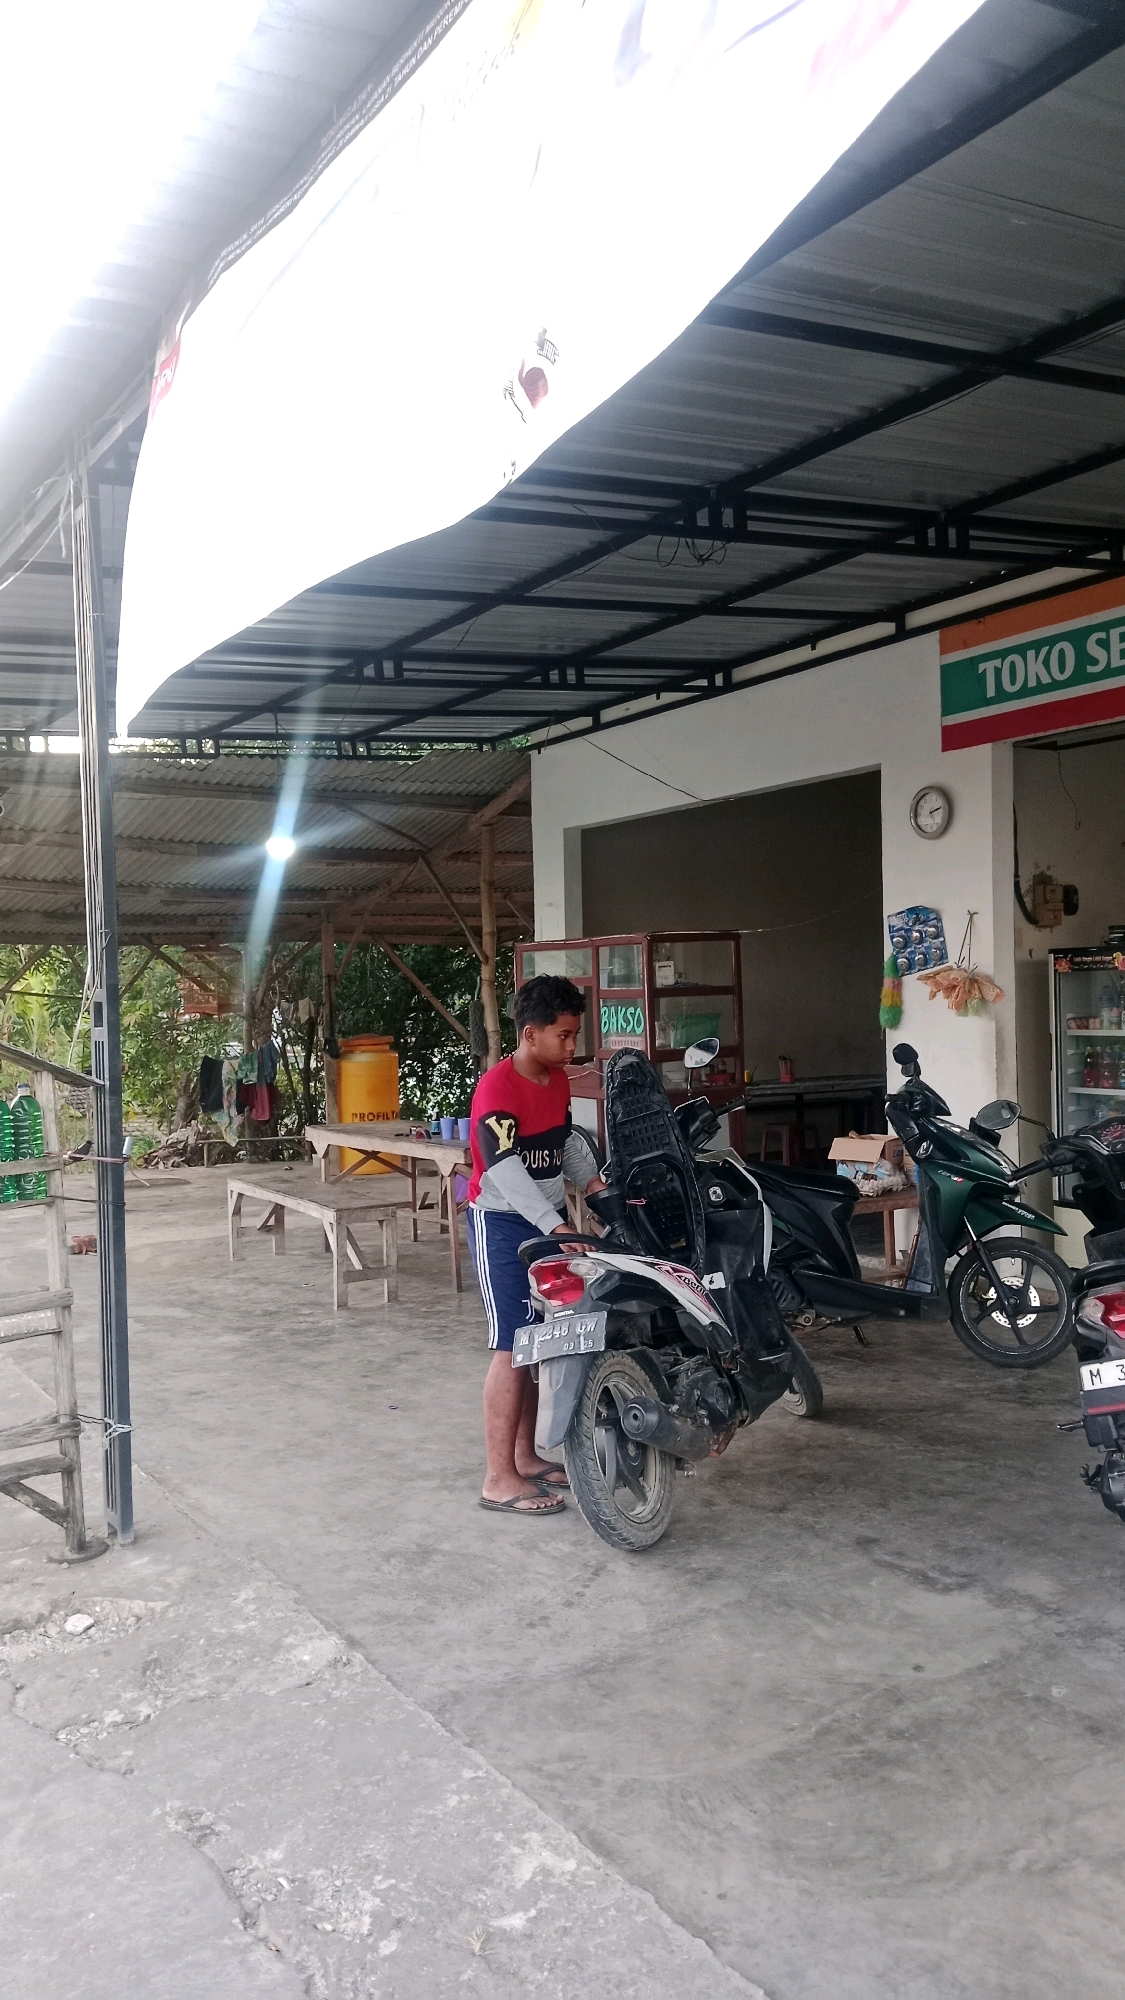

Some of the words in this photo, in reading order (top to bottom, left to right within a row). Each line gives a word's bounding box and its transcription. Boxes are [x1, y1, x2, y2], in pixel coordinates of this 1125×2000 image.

[394, 53, 417, 88] TAHUN
[417, 33, 434, 60] DAN
[978, 641, 1076, 699] TOKO
[1086, 625, 1125, 673] SE
[601, 1006, 644, 1035] BAKSO
[553, 1309, 575, 1318] HONDA
[563, 1341, 576, 1351] 03
[583, 1339, 595, 1349] 25
[1089, 1368, 1102, 1386] M
